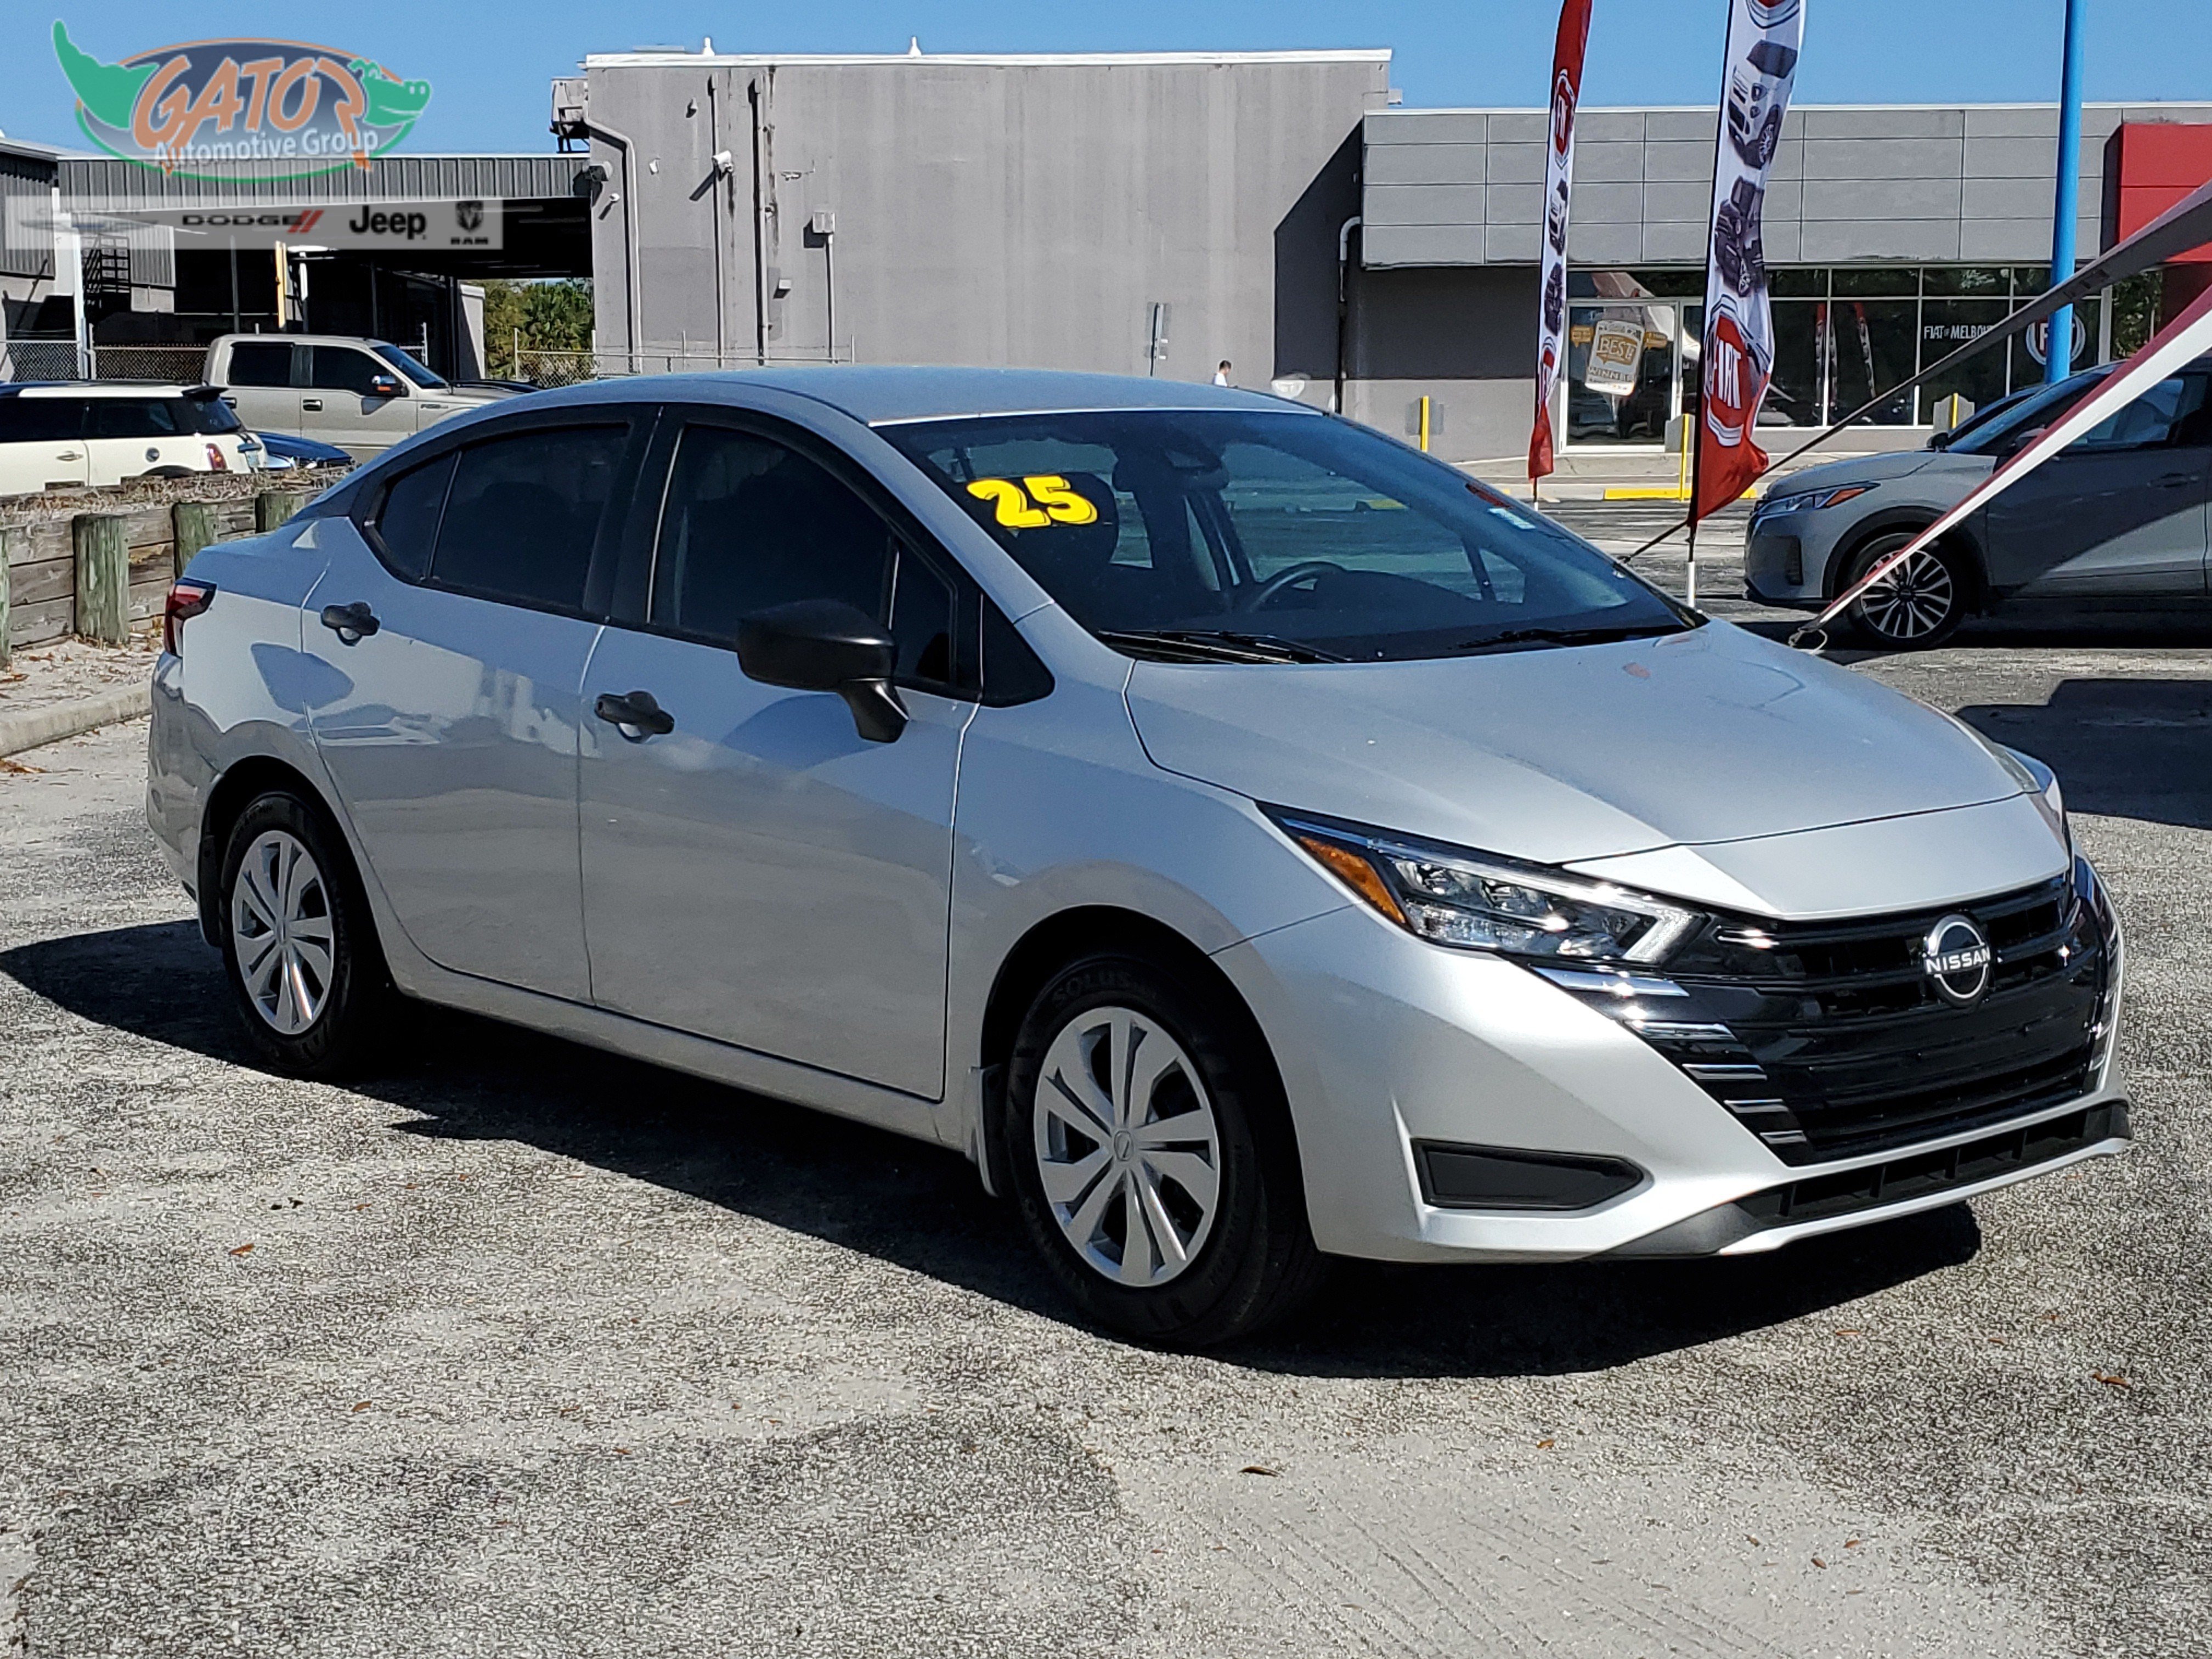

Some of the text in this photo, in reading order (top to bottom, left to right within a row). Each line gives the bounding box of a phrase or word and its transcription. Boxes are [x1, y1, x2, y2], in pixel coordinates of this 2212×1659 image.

[1923, 325, 1944, 339] FIAT
[1950, 325, 1994, 340] MELBOU
[966, 475, 1098, 529] 25
[1926, 947, 1991, 973] NISSAN
